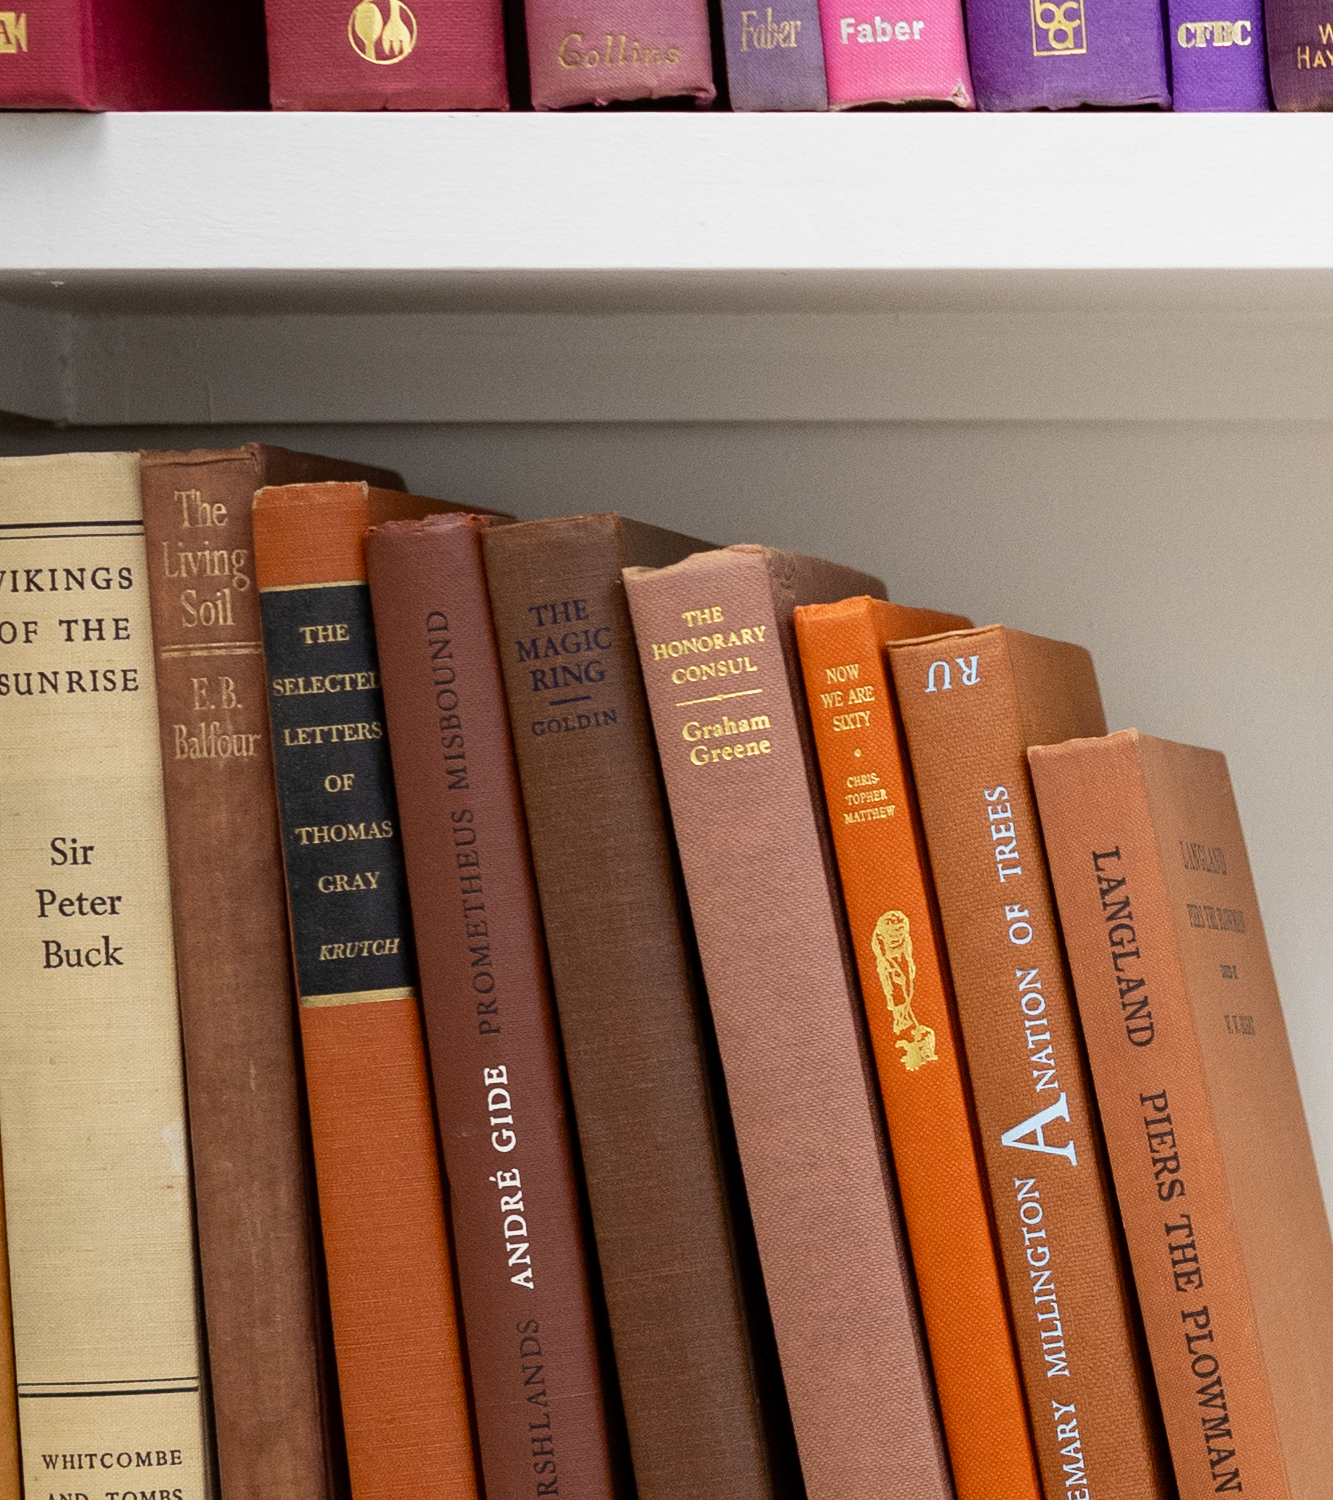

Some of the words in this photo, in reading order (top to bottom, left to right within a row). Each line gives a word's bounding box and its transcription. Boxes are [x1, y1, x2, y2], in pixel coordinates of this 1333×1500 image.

[839, 15, 926, 45] Faber
[173, 489, 228, 529] The
[180, 588, 235, 628] Soil
[651, 626, 768, 661] HONORARY
[530, 662, 606, 693] RING
[671, 658, 758, 686] CONSUL
[826, 664, 860, 685] NOW
[172, 724, 262, 760] Balfour
[283, 722, 383, 746] LETTERS
[681, 713, 771, 744] Graham
[690, 737, 772, 766] Greene
[295, 820, 394, 845] THOMAS
[50, 837, 95, 866] Sir
[317, 871, 382, 894] GRAY
[36, 889, 122, 918] Peter
[42, 934, 123, 969] Buck
[1092, 845, 1156, 1049] LANGLAND
[1139, 1089, 1187, 1202] PIERS
[1163, 1213, 1203, 1294] THE
[1181, 1305, 1243, 1495] PLOWMAN
[41, 1449, 184, 1471] WHITCOMBE
